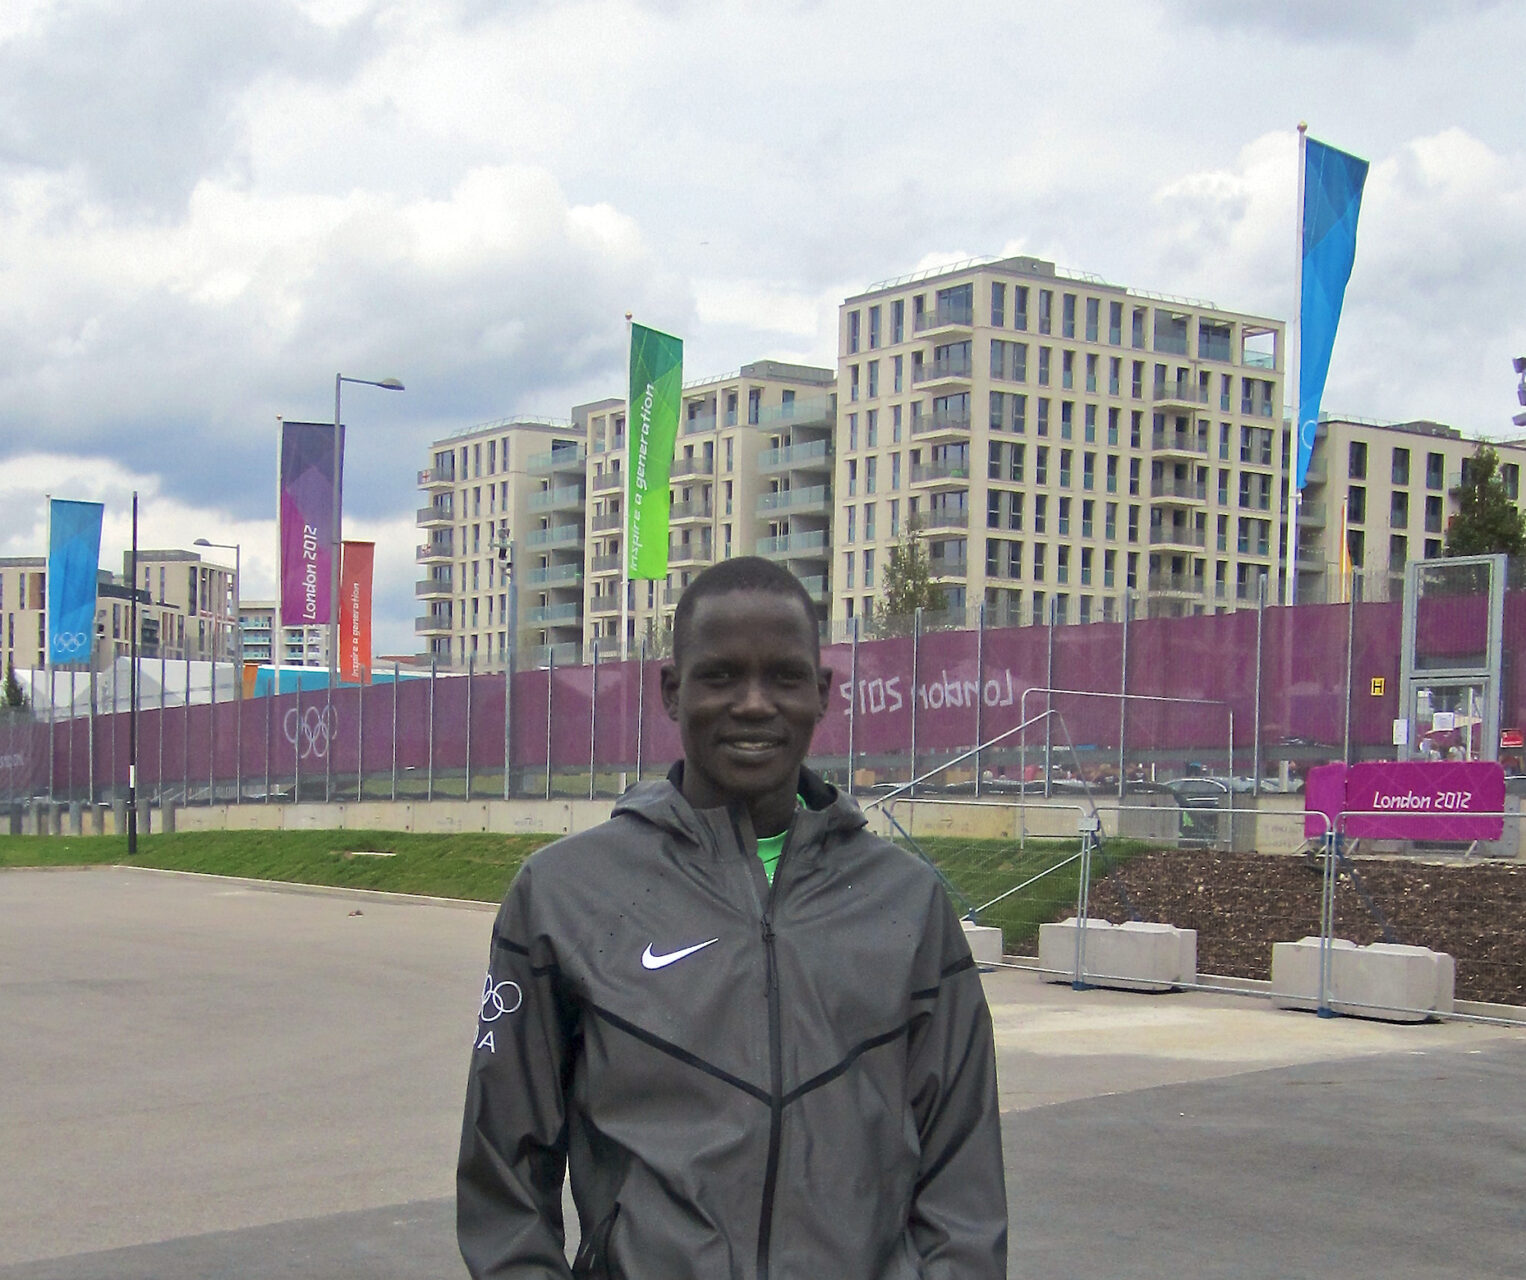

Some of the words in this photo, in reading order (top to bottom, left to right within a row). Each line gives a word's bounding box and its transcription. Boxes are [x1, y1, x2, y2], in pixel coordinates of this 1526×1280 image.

[635, 382, 655, 491] generation
[303, 524, 317, 561] 2012
[302, 563, 317, 620] London
[351, 583, 360, 636] generation
[1372, 679, 1383, 694] H
[1373, 790, 1431, 809] London
[1434, 791, 1472, 809] 2012
